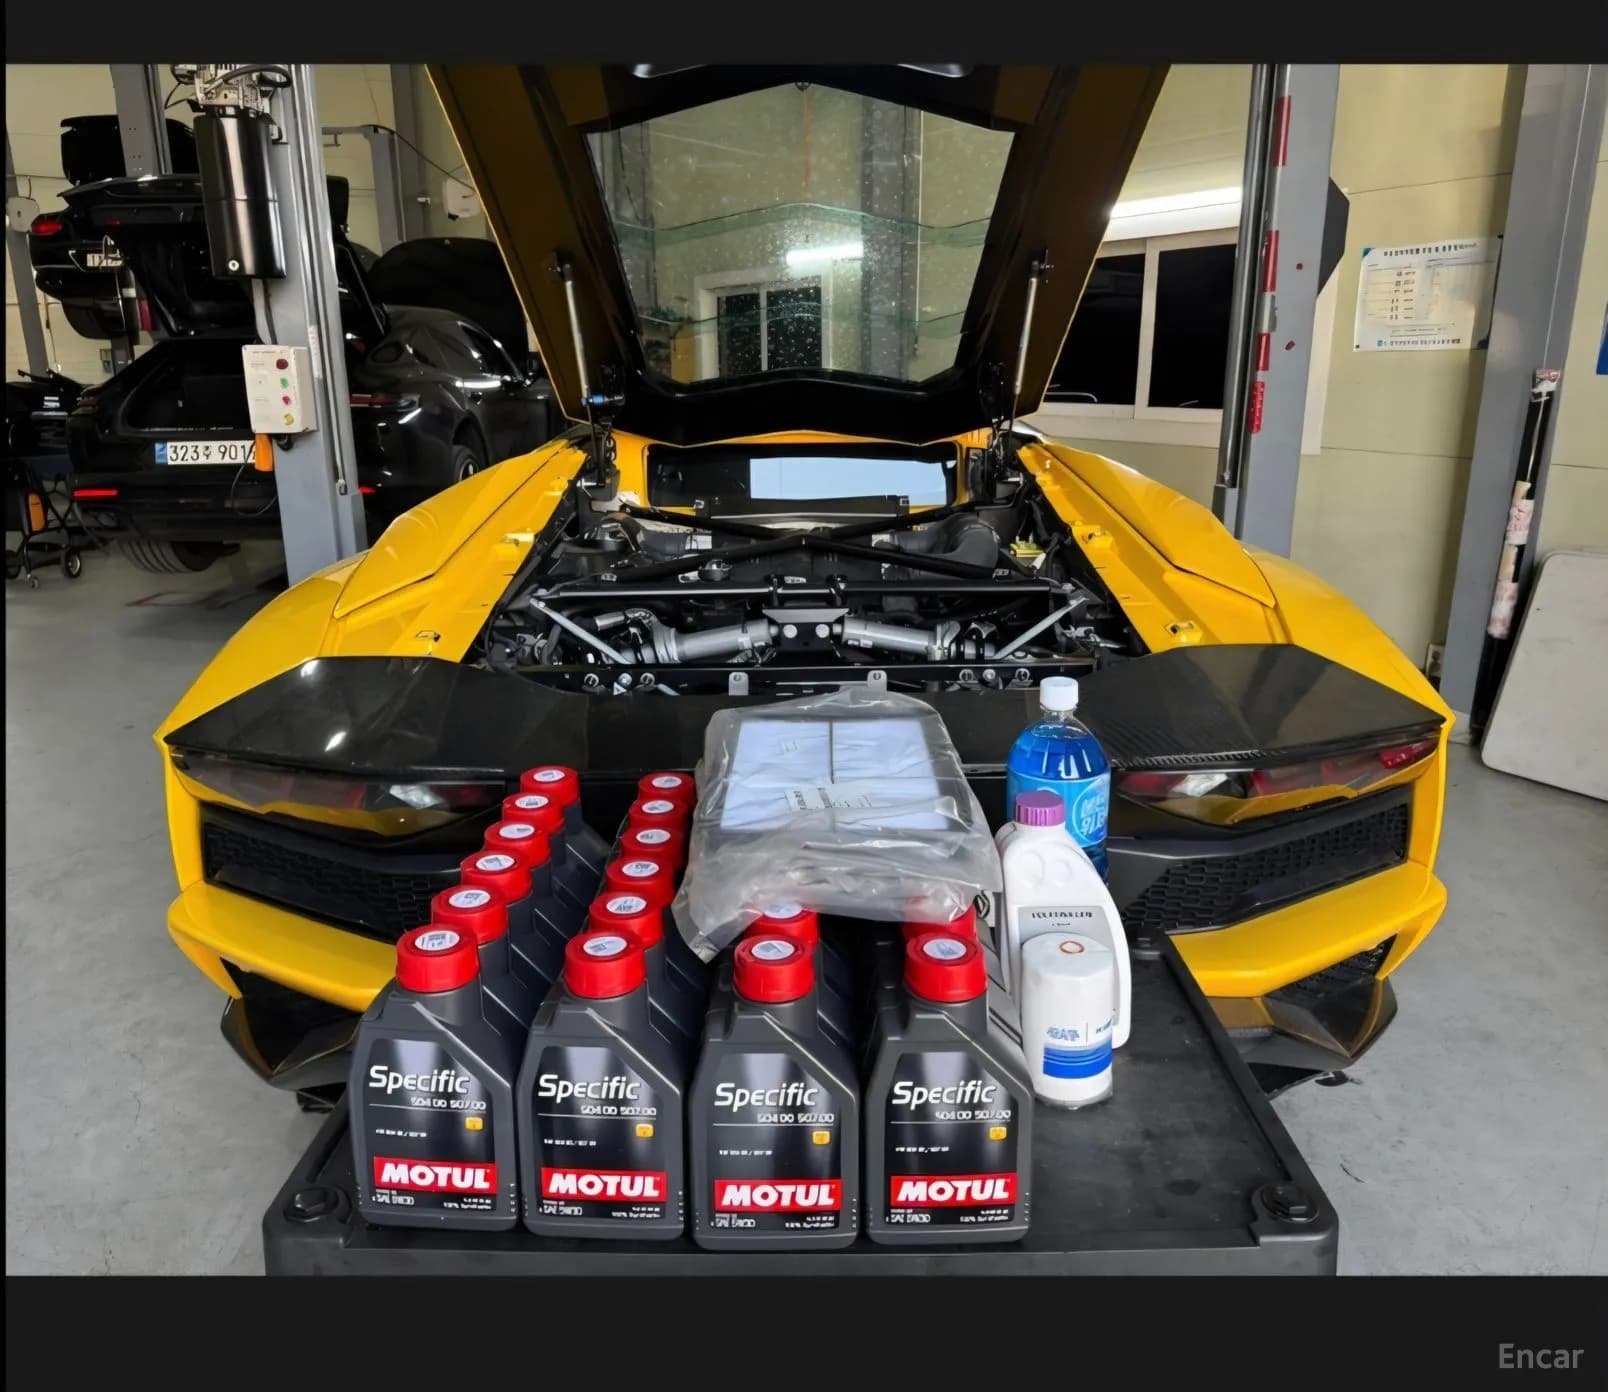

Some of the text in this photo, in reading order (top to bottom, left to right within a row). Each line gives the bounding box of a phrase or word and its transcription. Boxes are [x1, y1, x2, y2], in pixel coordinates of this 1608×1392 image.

[368, 1064, 471, 1095] Specific
[537, 1074, 642, 1104] Specific
[713, 1082, 819, 1112] Specific
[891, 1080, 997, 1111] Specific
[381, 1162, 491, 1189] MOTUL
[549, 1172, 660, 1197] MOTUL
[721, 1184, 835, 1207] MOTUL
[897, 1178, 1010, 1202] MOTUL
